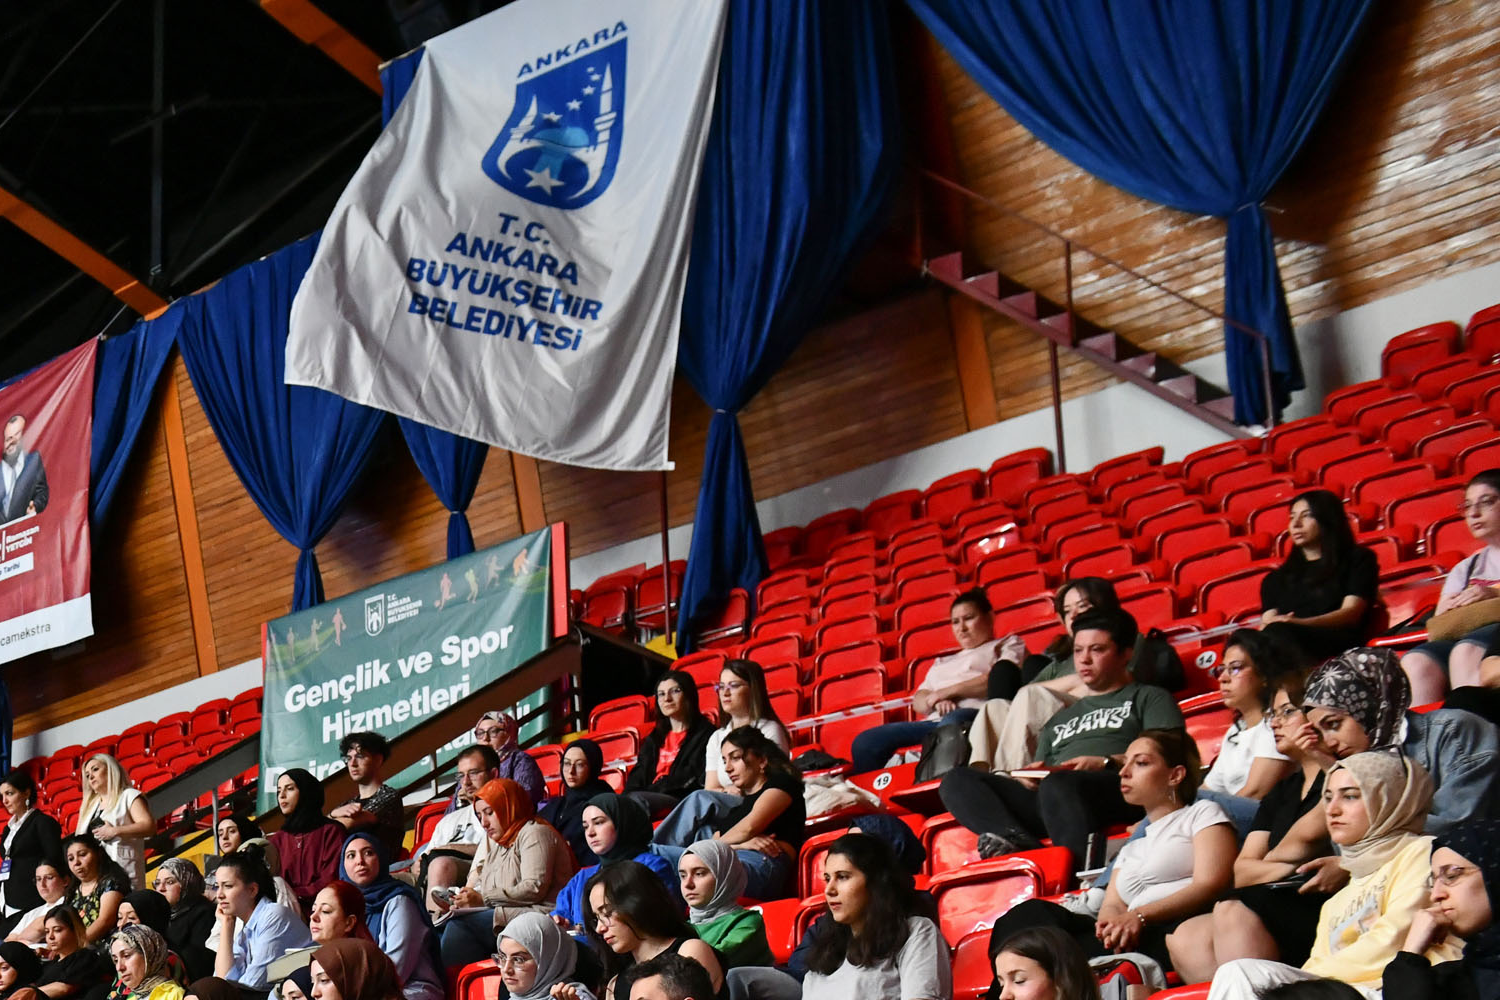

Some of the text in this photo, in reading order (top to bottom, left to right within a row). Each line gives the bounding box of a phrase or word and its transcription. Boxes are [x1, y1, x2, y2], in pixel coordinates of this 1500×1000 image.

[517, 20, 629, 78] ANKARA
[498, 213, 551, 246] T.C.
[445, 232, 578, 285] ANKARA
[405, 257, 603, 321] BÜYÜKŞEHİR
[408, 294, 582, 351] BELEDİYESİ
[284, 625, 514, 713] Gençlik ve Spor
[1199, 654, 1213, 666] 14
[322, 674, 471, 744] Hizmetleri
[876, 775, 889, 787] 19
